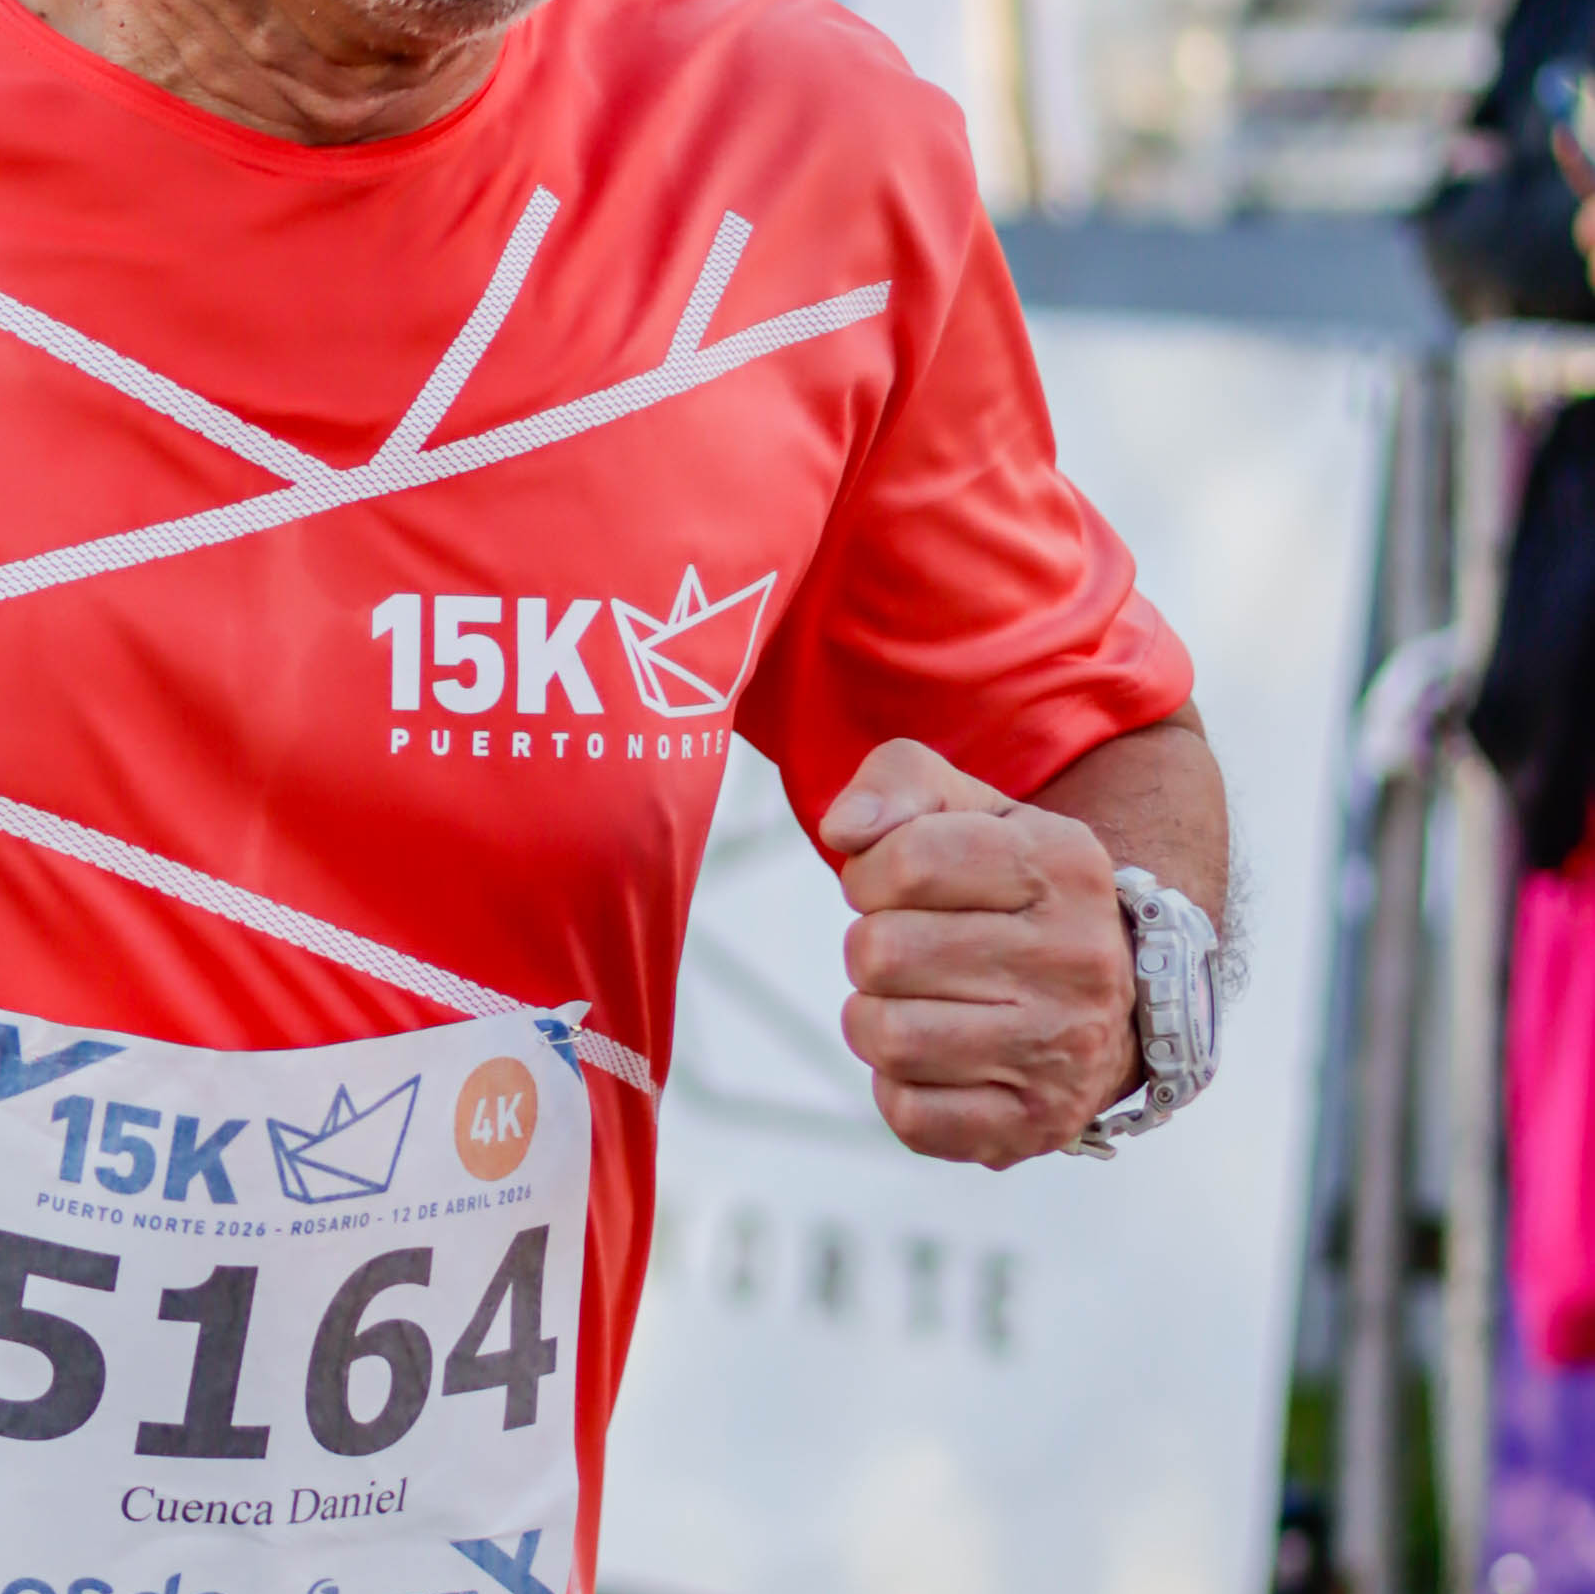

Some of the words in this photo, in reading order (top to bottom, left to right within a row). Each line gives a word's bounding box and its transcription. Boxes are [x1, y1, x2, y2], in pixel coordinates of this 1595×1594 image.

[372, 593, 605, 715] 15K
[390, 728, 605, 759] PUERTO
[627, 728, 724, 760] NORTE
[470, 1092, 524, 1146] 4K
[51, 1094, 251, 1205] 15K
[37, 1192, 123, 1225] PUERTO
[133, 1213, 206, 1236] NORTE
[214, 1220, 267, 1237] 2026
[290, 1212, 371, 1236] ROSARIO
[392, 1207, 411, 1224] 12
[418, 1202, 438, 1220] DE
[445, 1194, 492, 1216] ABRIL
[497, 1184, 533, 1206] 2026
[120, 1486, 274, 1526] Cuenca
[286, 1476, 408, 1525] Daniel
